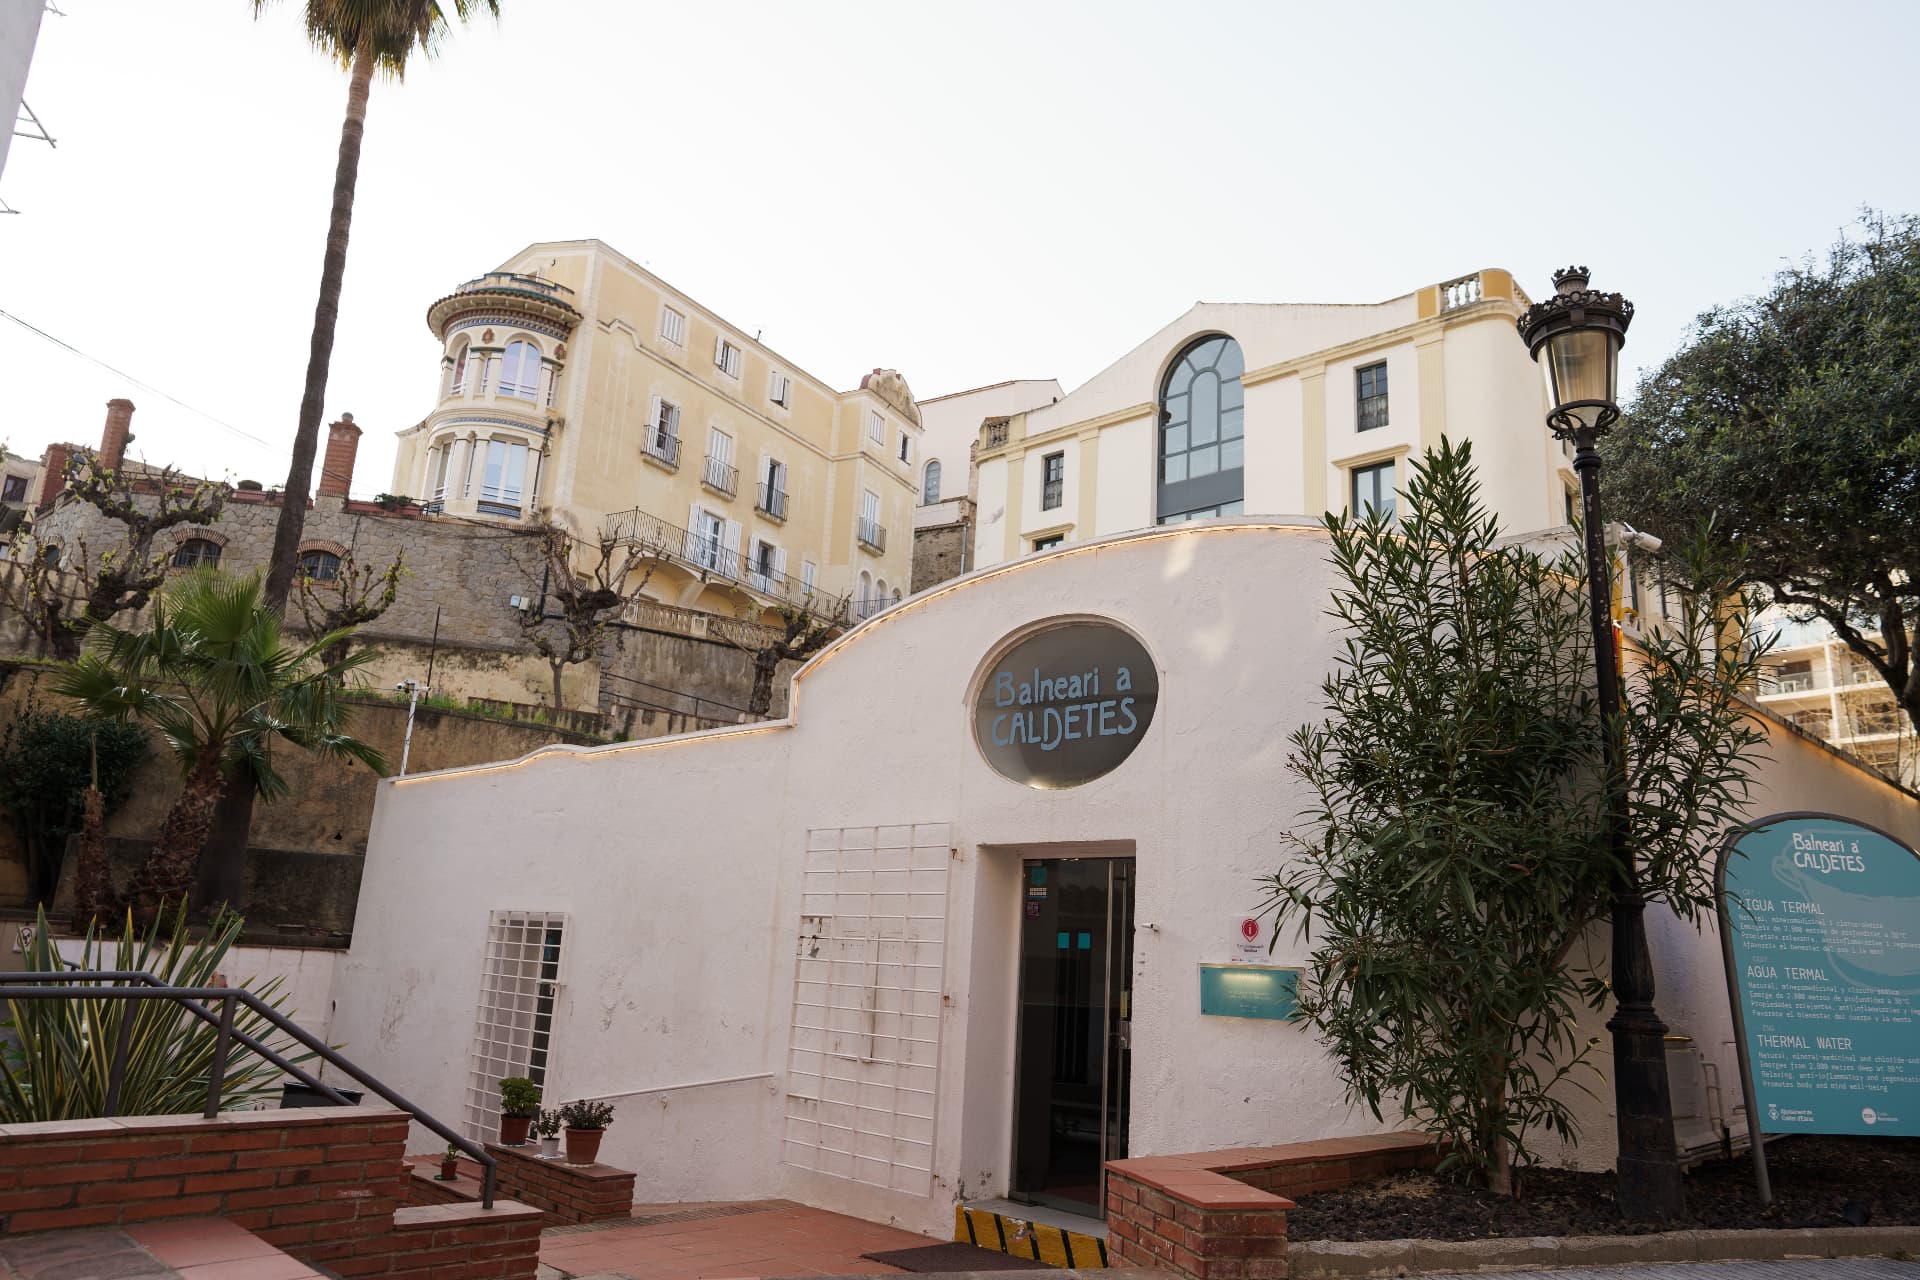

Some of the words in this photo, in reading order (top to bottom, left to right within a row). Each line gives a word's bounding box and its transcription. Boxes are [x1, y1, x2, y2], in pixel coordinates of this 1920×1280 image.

[995, 667, 1099, 708] Balneari
[1116, 667, 1132, 691] a
[991, 697, 1138, 750] CALDETES
[1792, 832, 1845, 853] Balneari
[1793, 851, 1865, 874] CALDETES
[1782, 901, 1824, 915] TERMAL
[1747, 965, 1777, 978] AGUA
[1784, 967, 1829, 981] TERMAL
[1756, 1034, 1811, 1049] THERMAL
[1817, 1036, 1852, 1050] WATER
